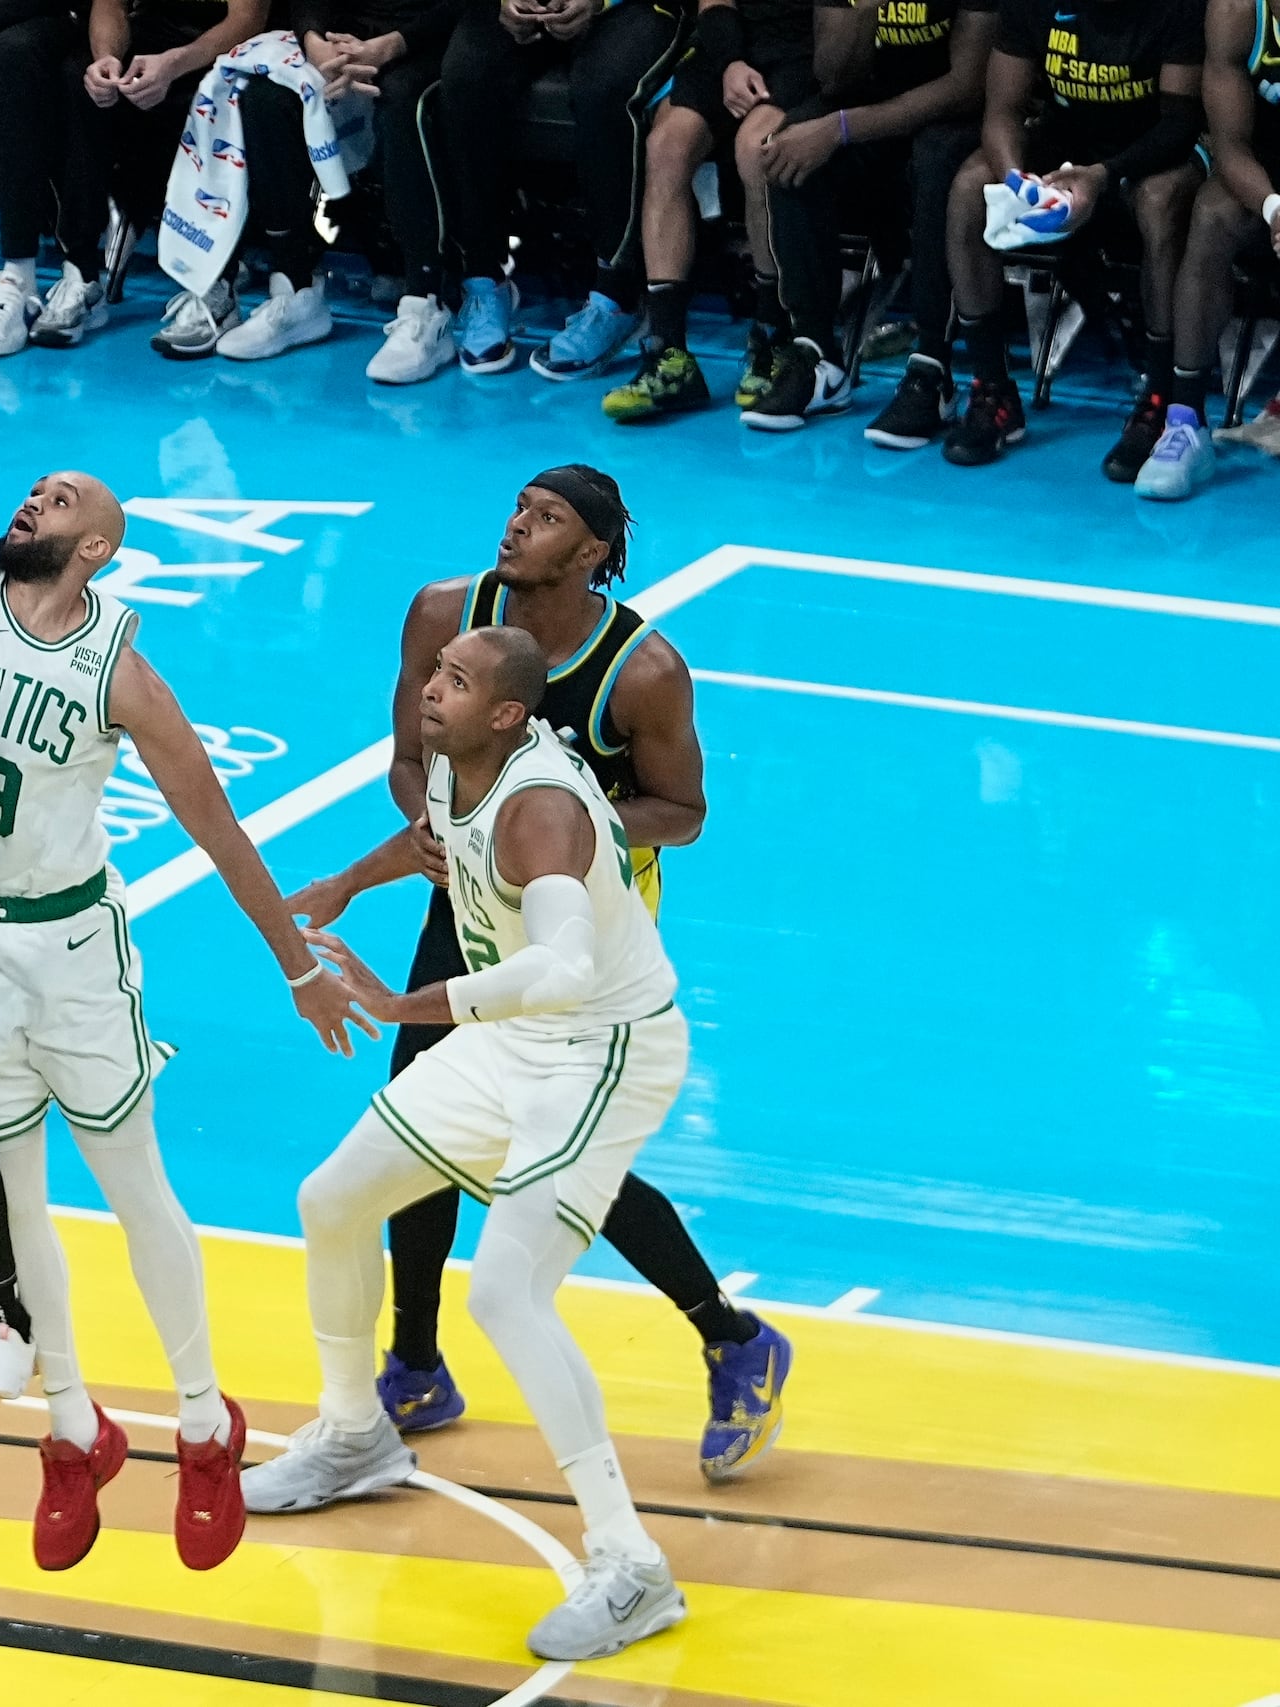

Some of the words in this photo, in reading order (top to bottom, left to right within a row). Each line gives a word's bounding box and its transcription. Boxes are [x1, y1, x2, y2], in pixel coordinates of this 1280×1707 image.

[877, 1, 927, 24] EASON
[1047, 27, 1078, 56] NBA
[1045, 53, 1130, 84] IN-SEASON
[1047, 74, 1153, 102] TOURNAMENT
[162, 208, 215, 253] ssociation
[70, 659, 100, 678] PRINT
[75, 646, 102, 667] VISTA
